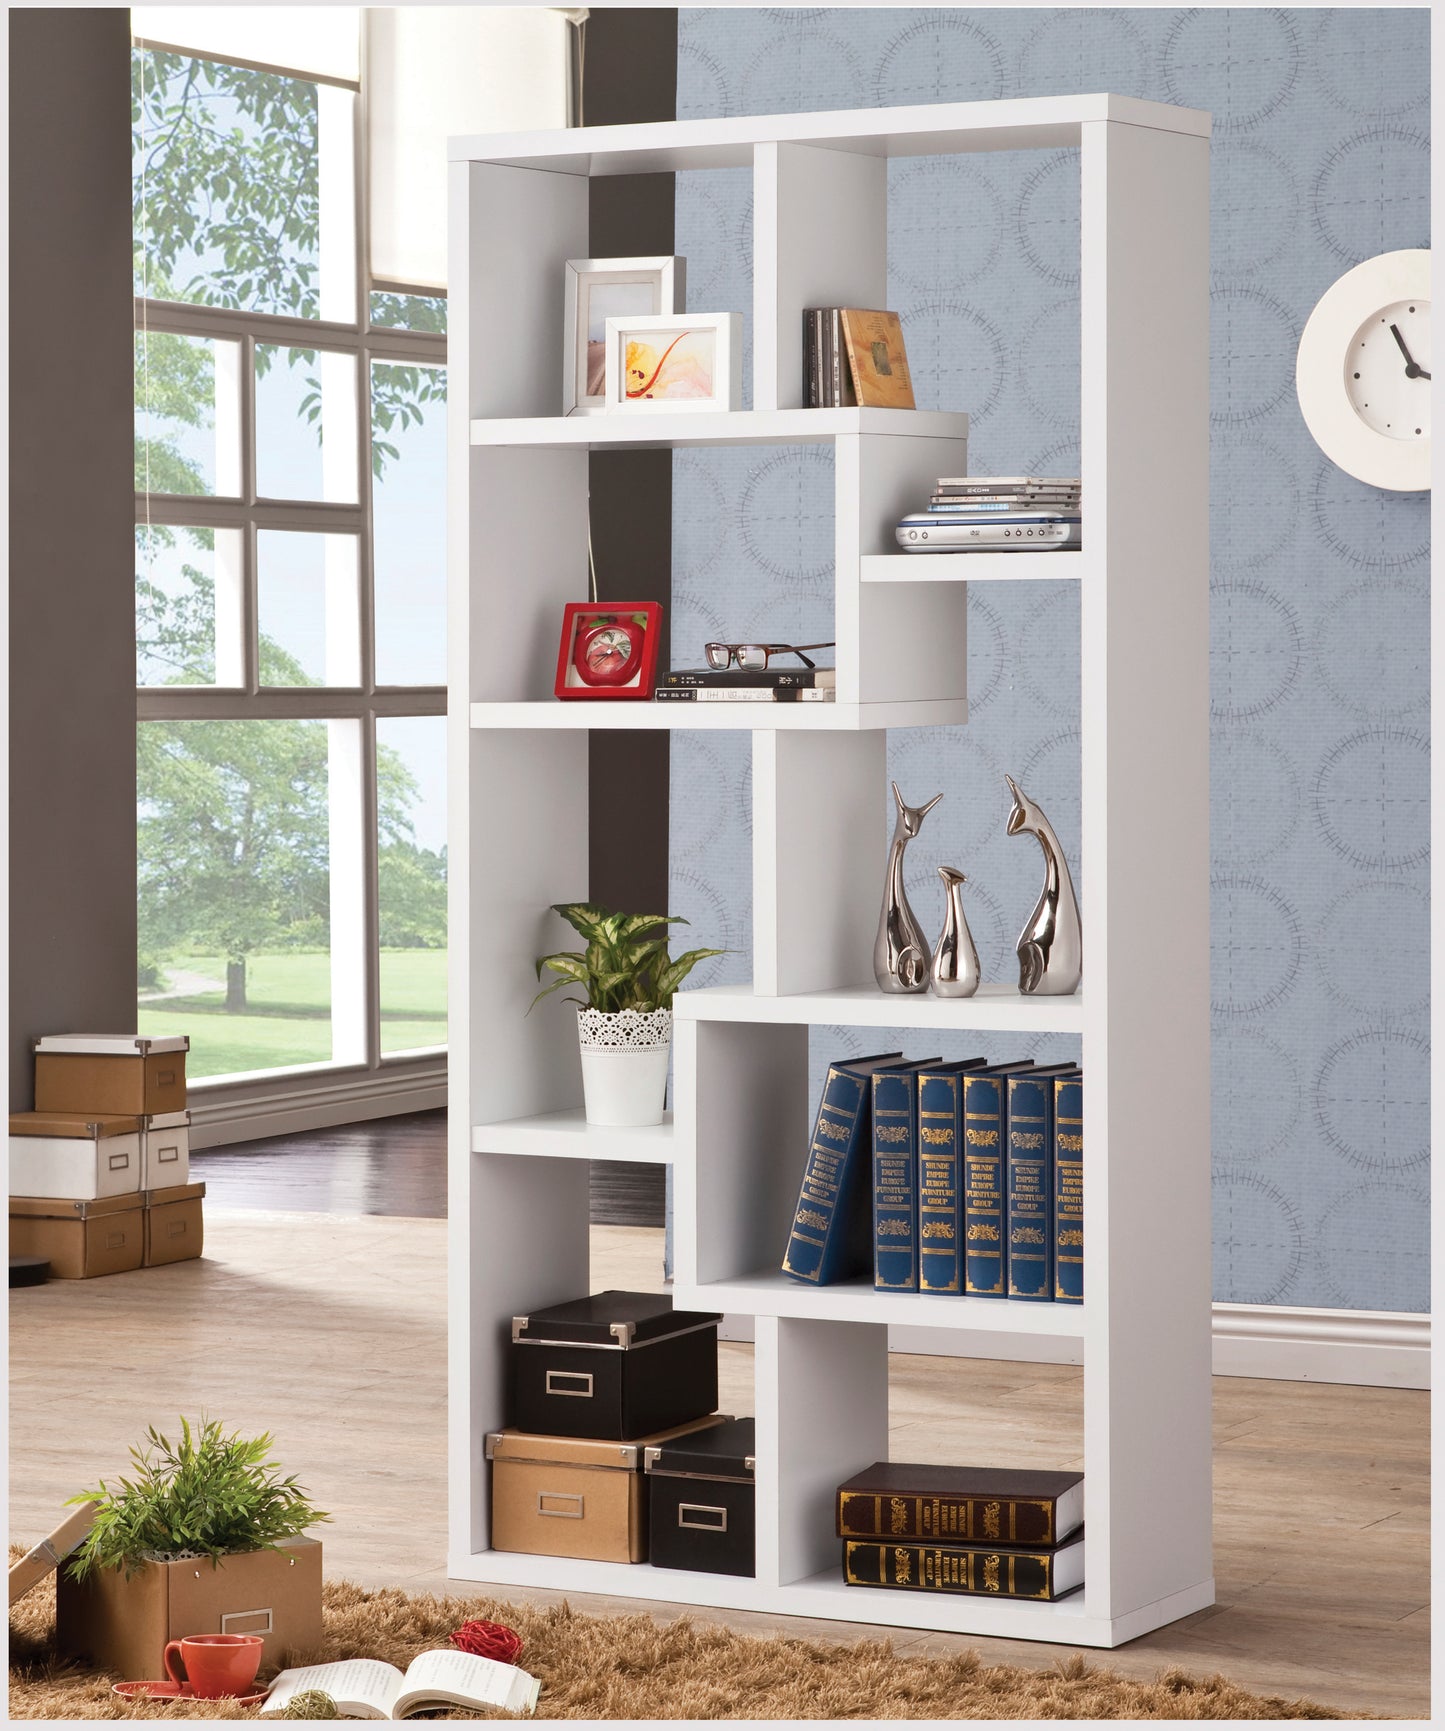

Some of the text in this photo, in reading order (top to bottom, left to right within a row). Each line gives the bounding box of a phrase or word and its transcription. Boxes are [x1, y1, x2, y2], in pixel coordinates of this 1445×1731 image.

[925, 1162, 950, 1170] SHUNDE
[970, 1163, 995, 1172] SHUNDE
[926, 1170, 950, 1179] EMPIRE
[971, 1172, 995, 1181] EMPIRE
[926, 1179, 950, 1188] EUROPE
[971, 1181, 995, 1190] EUROPE
[876, 1186, 911, 1194] FURNITURE
[921, 1187, 956, 1197] FURNITURE
[1015, 1184, 1040, 1193] EUROPE
[966, 1189, 1001, 1199] FURNITURE
[1011, 1192, 1047, 1202] FURNITURE
[927, 1197, 949, 1205] GROUP
[972, 1199, 993, 1207] GROUP
[1017, 1202, 1039, 1211] GROUP
